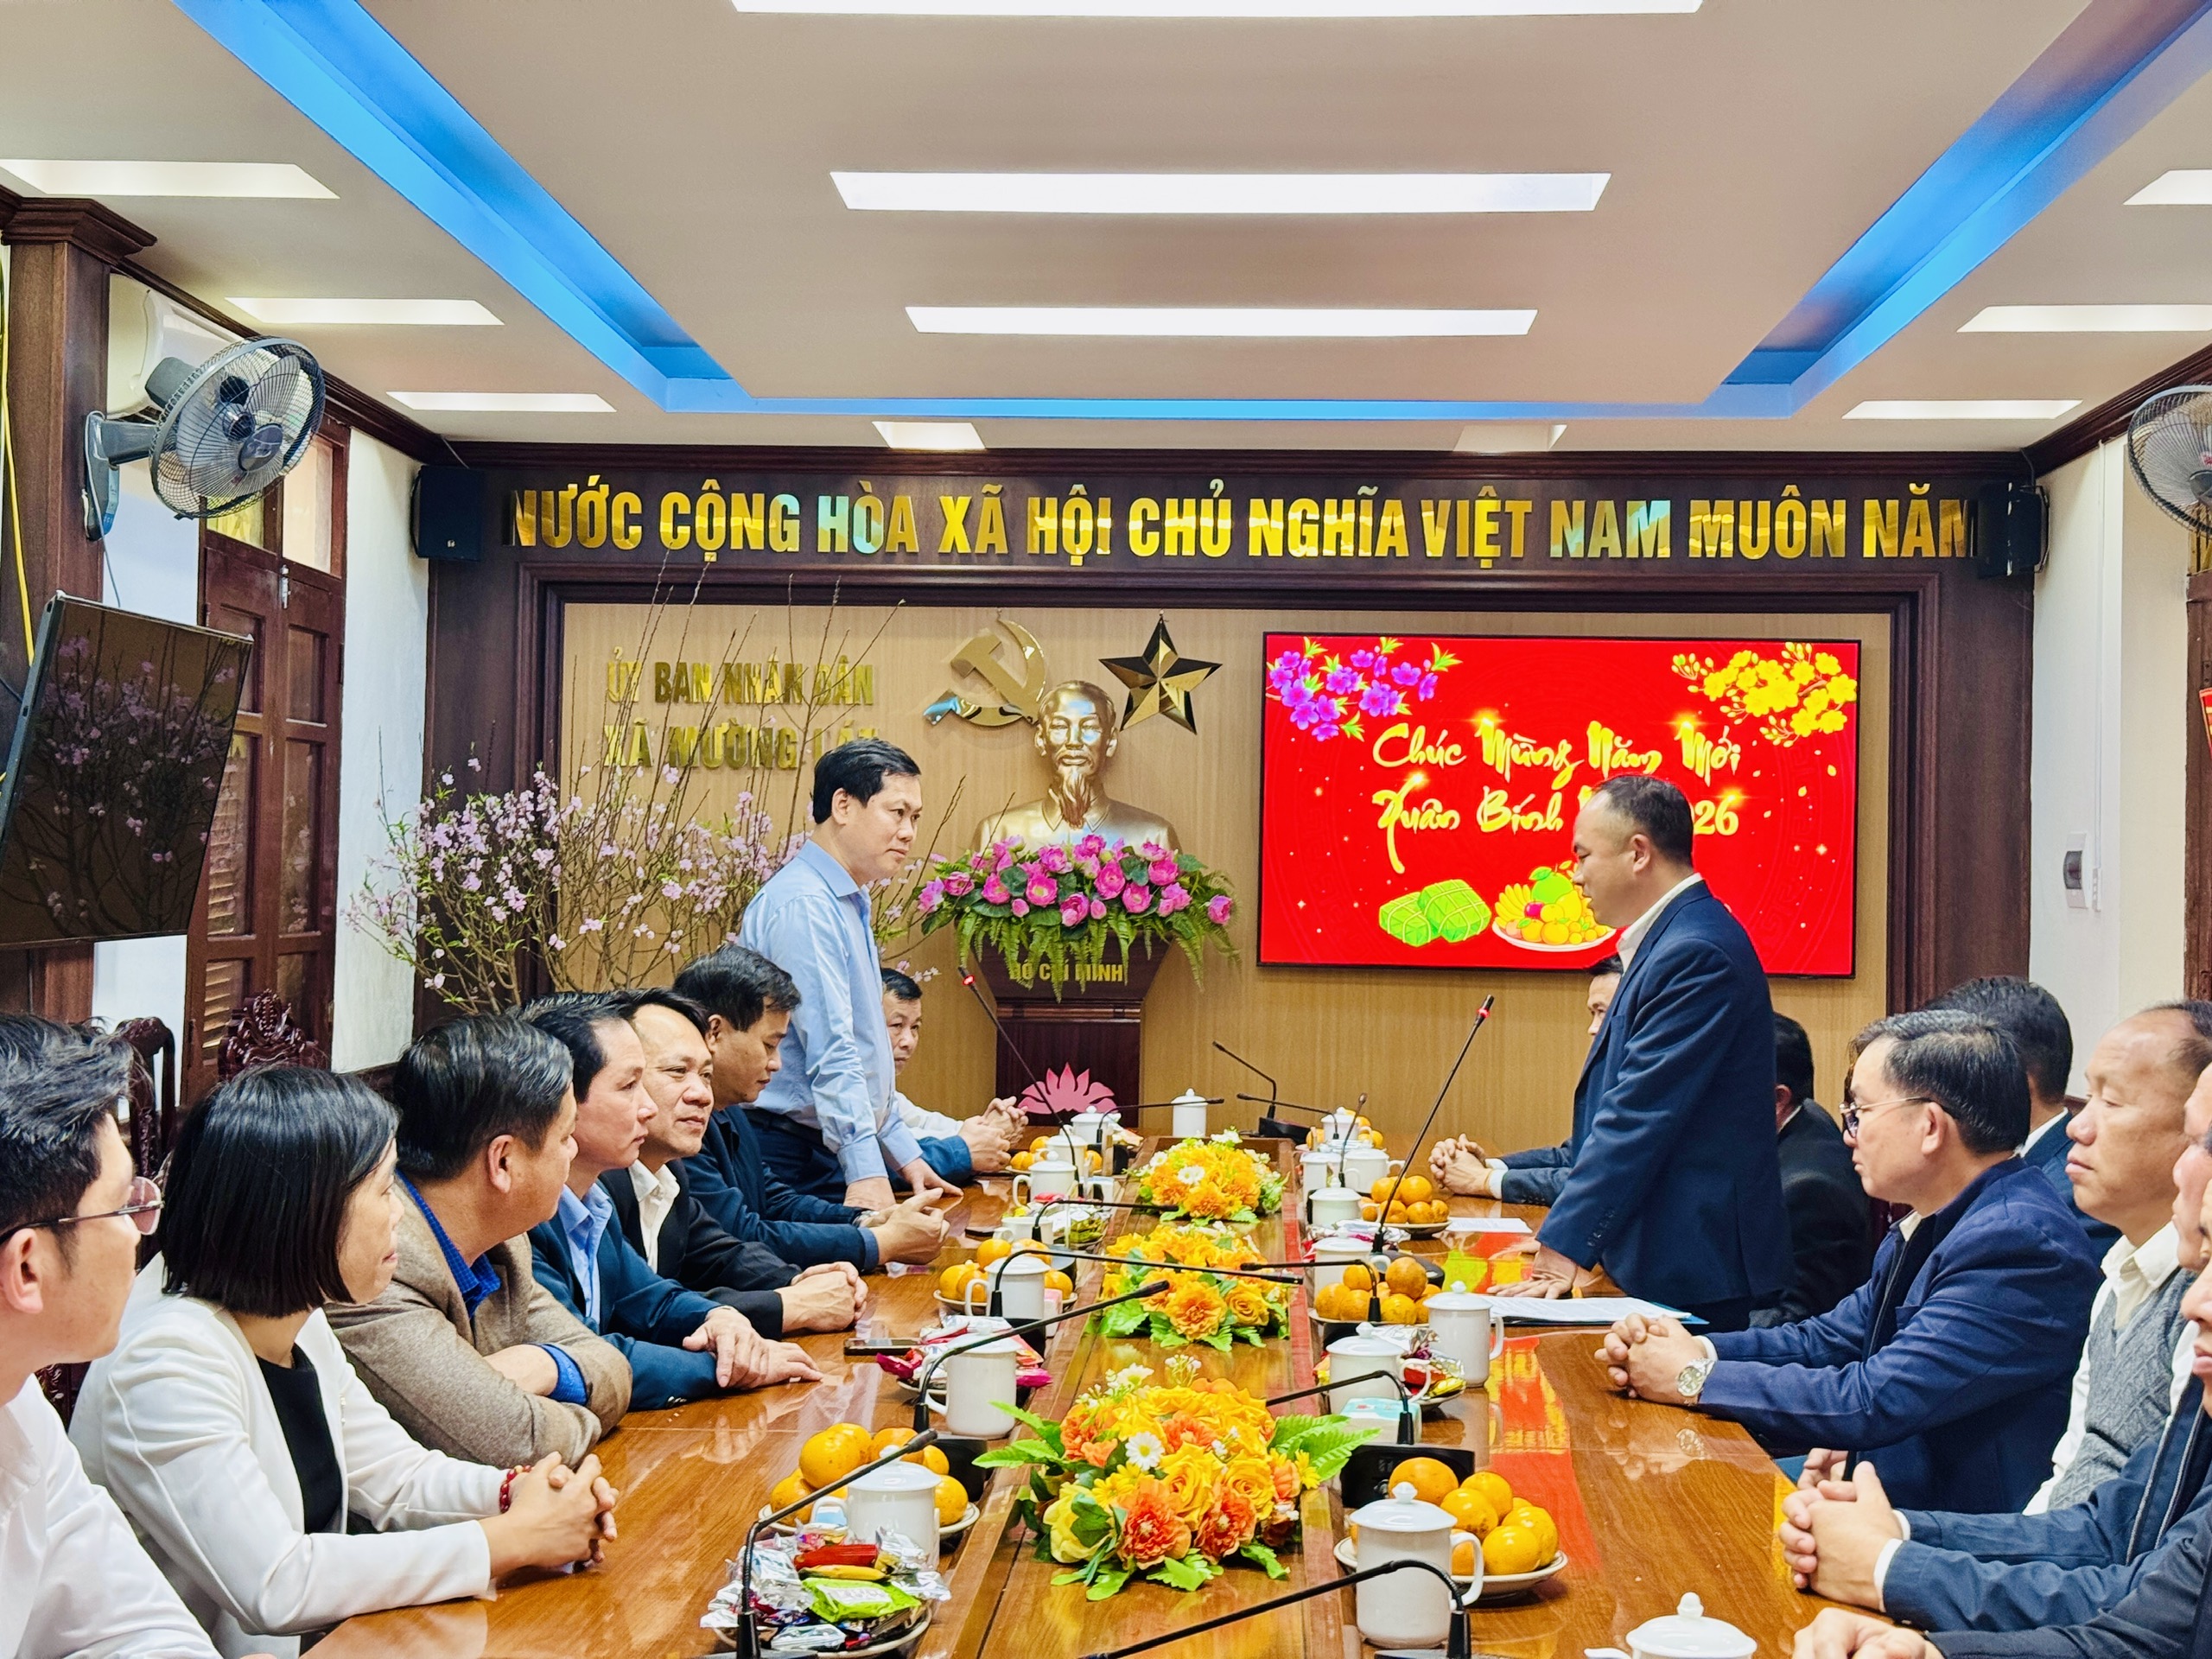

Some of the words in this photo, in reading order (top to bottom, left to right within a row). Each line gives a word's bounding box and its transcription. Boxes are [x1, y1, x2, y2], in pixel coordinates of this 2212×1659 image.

[502, 474, 643, 549] NƯỚC
[659, 479, 800, 562] CỘNG
[817, 480, 920, 554] HÒA
[938, 483, 1008, 555] XÃ
[1027, 484, 1111, 566] HỘI
[1128, 479, 1232, 557] CHỦ
[1249, 486, 1409, 557] NGHĨA
[1421, 486, 1532, 568] VIỆT
[1550, 499, 1671, 558] NAM
[1688, 484, 1846, 560] MUÔN
[654, 662, 712, 704] BAN
[723, 654, 804, 704] NHÂN
[815, 655, 874, 705] DÂN
[604, 717, 653, 767] XÃ
[1372, 722, 1466, 767] Chúc
[1474, 716, 1584, 790] Mừng
[1586, 720, 1662, 780] Năm
[1674, 721, 1742, 787] Mới
[1372, 775, 1460, 874] Xuân
[1476, 785, 1564, 835] Bính
[1689, 794, 1738, 836] 26
[1039, 959, 1069, 981] CÍ
